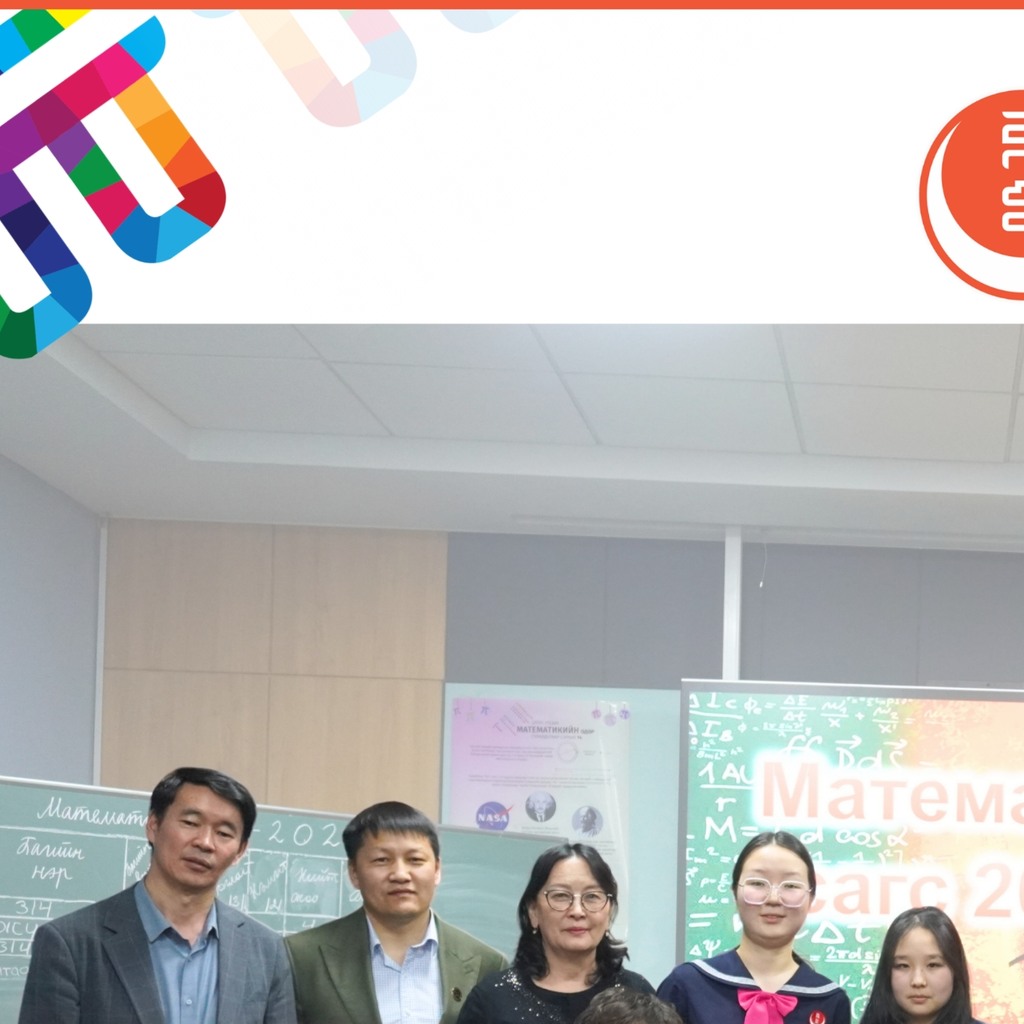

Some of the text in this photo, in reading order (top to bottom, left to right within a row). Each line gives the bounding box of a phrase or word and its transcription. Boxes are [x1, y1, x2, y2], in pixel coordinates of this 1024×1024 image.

[516, 725, 580, 734] МАТЕМАТИКИЙН
[478, 813, 508, 823] NASA
[808, 867, 948, 919] сагс
[15, 900, 52, 918] 314
